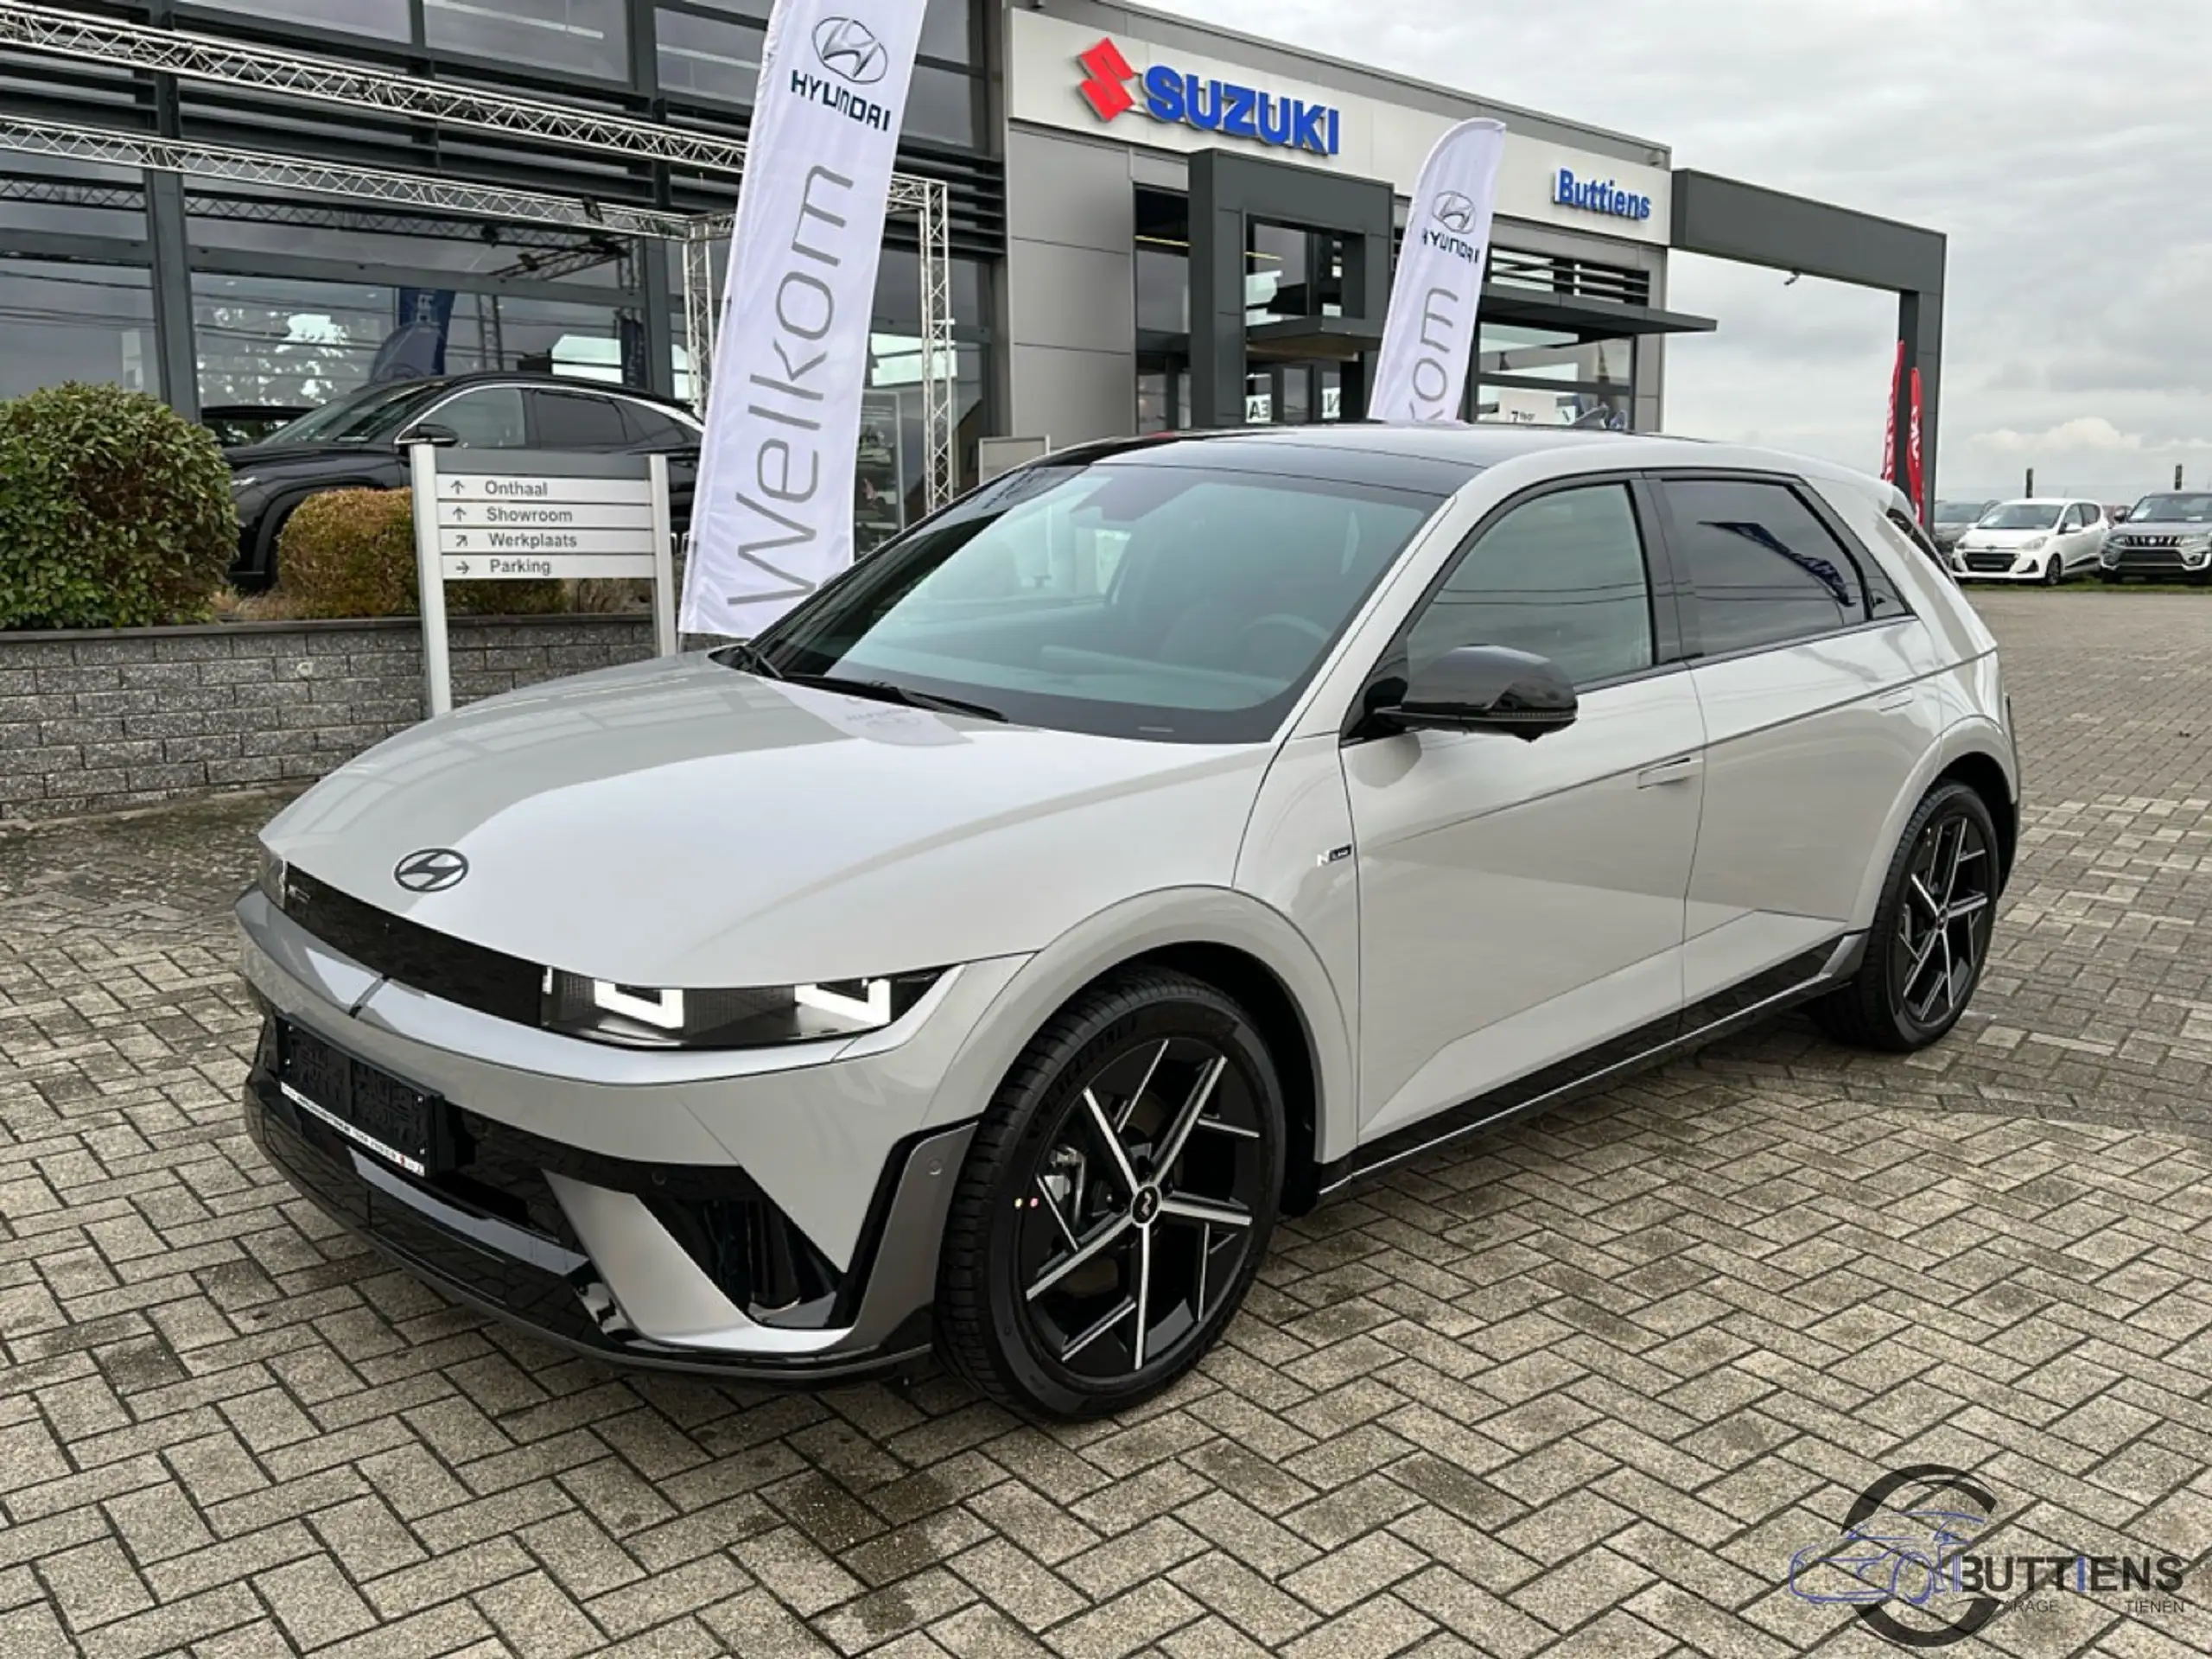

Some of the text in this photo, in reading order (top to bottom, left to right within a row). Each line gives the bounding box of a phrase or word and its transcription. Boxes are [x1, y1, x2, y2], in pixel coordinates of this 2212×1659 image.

[791, 69, 891, 131] HYUNDAI
[1142, 65, 1339, 156] SUZUKI
[1557, 167, 1651, 221] Buttiens
[727, 164, 855, 607] Welkom
[485, 480, 548, 496] Onthaal
[486, 507, 573, 523] Showroom
[487, 533, 577, 549] Werkplaats
[489, 559, 551, 576] Parking
